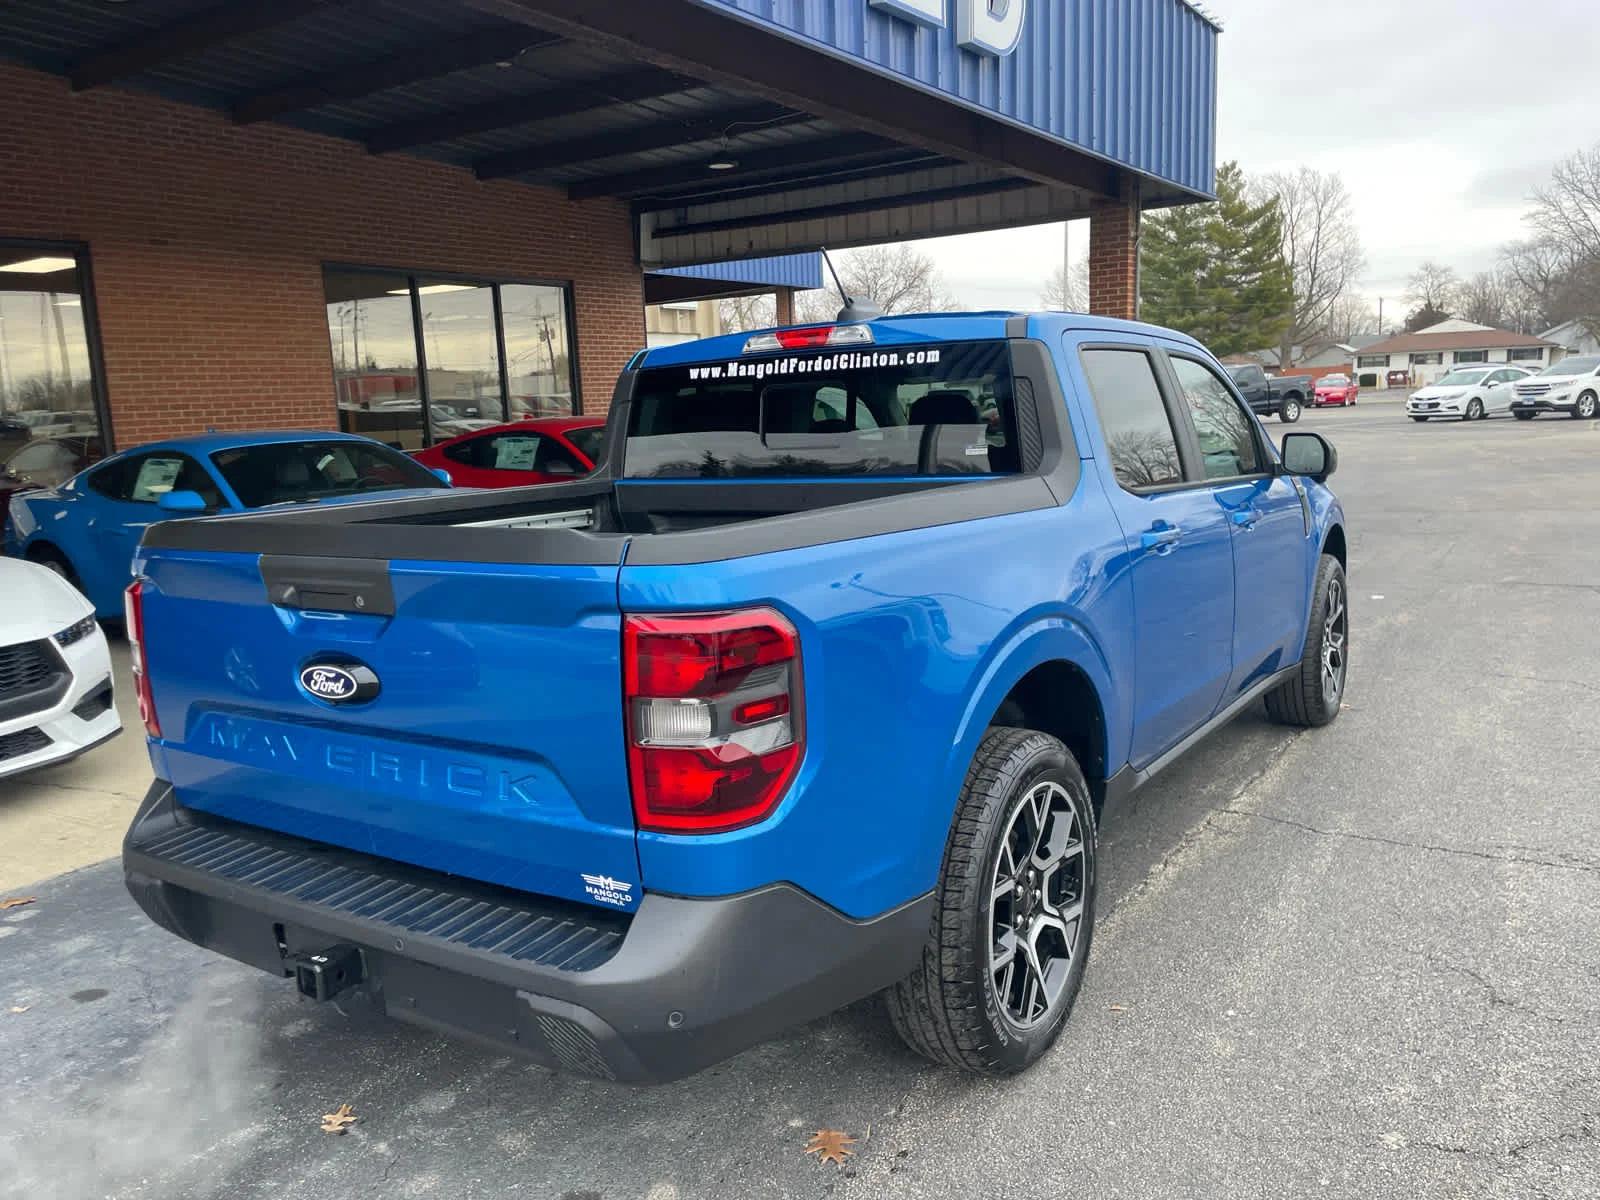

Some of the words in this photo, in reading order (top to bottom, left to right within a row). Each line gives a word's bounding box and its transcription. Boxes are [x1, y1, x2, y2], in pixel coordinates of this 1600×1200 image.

[689, 349, 940, 380] www.MangoldFordofClinton.com
[310, 669, 345, 694] Ford
[585, 885, 633, 902] MANGOLD
